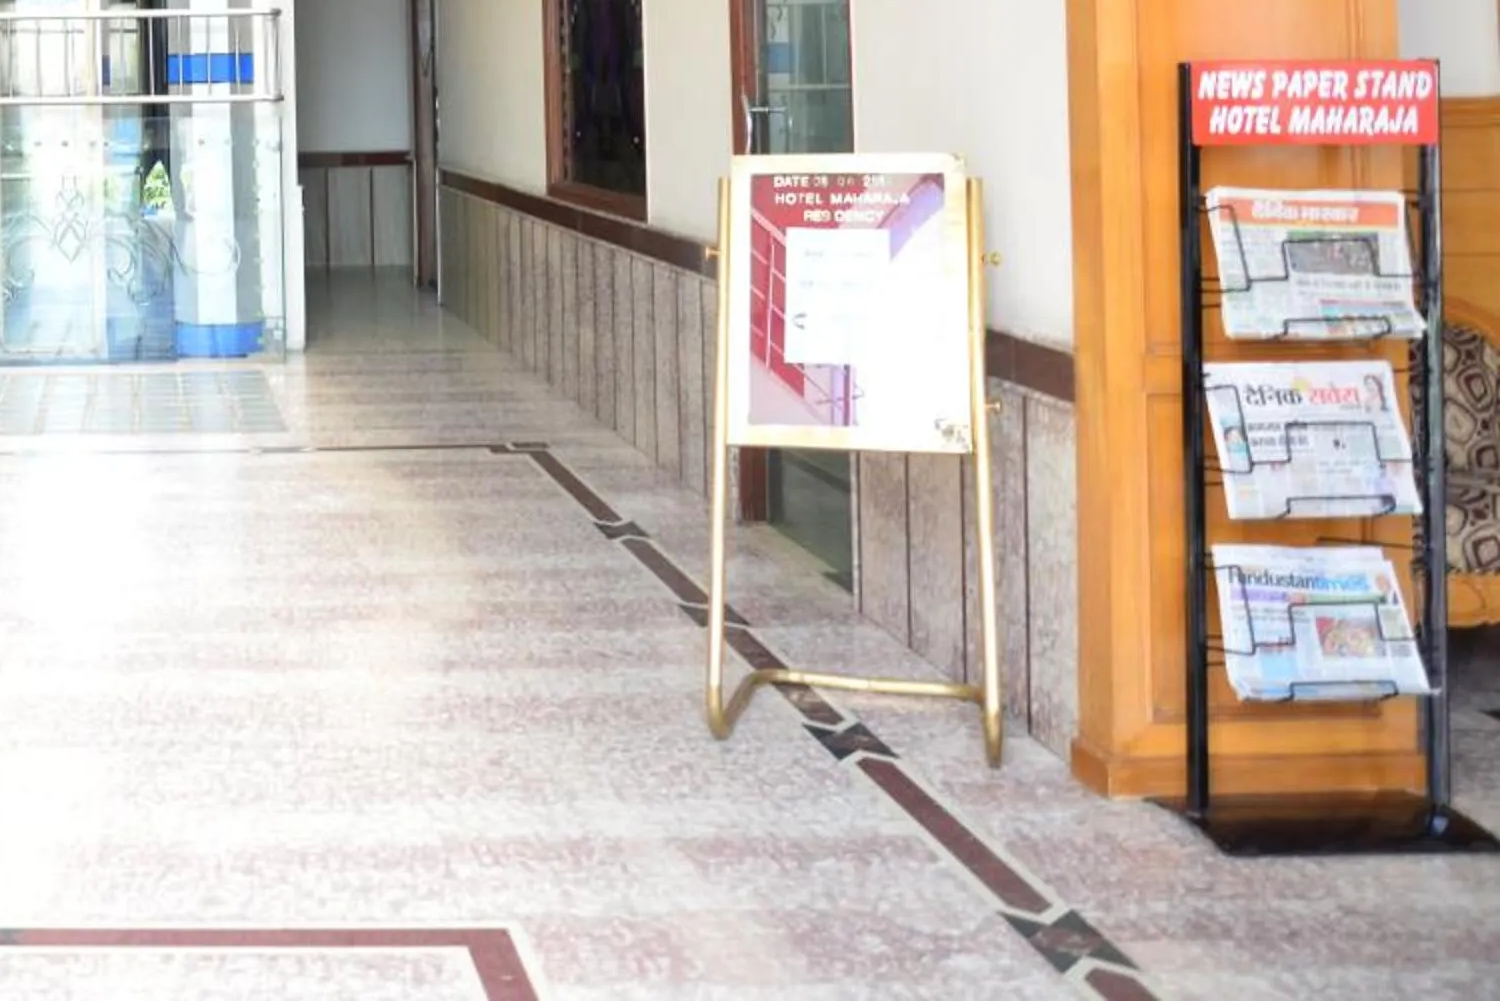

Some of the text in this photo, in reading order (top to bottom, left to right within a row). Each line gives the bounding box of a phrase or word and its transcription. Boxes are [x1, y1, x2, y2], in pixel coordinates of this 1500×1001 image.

[1198, 70, 1433, 100] NEWS PAPER STAND
[1209, 105, 1419, 136] HOTEL MAHARAJA
[772, 174, 810, 188] DATE
[774, 192, 823, 205] HOTEL
